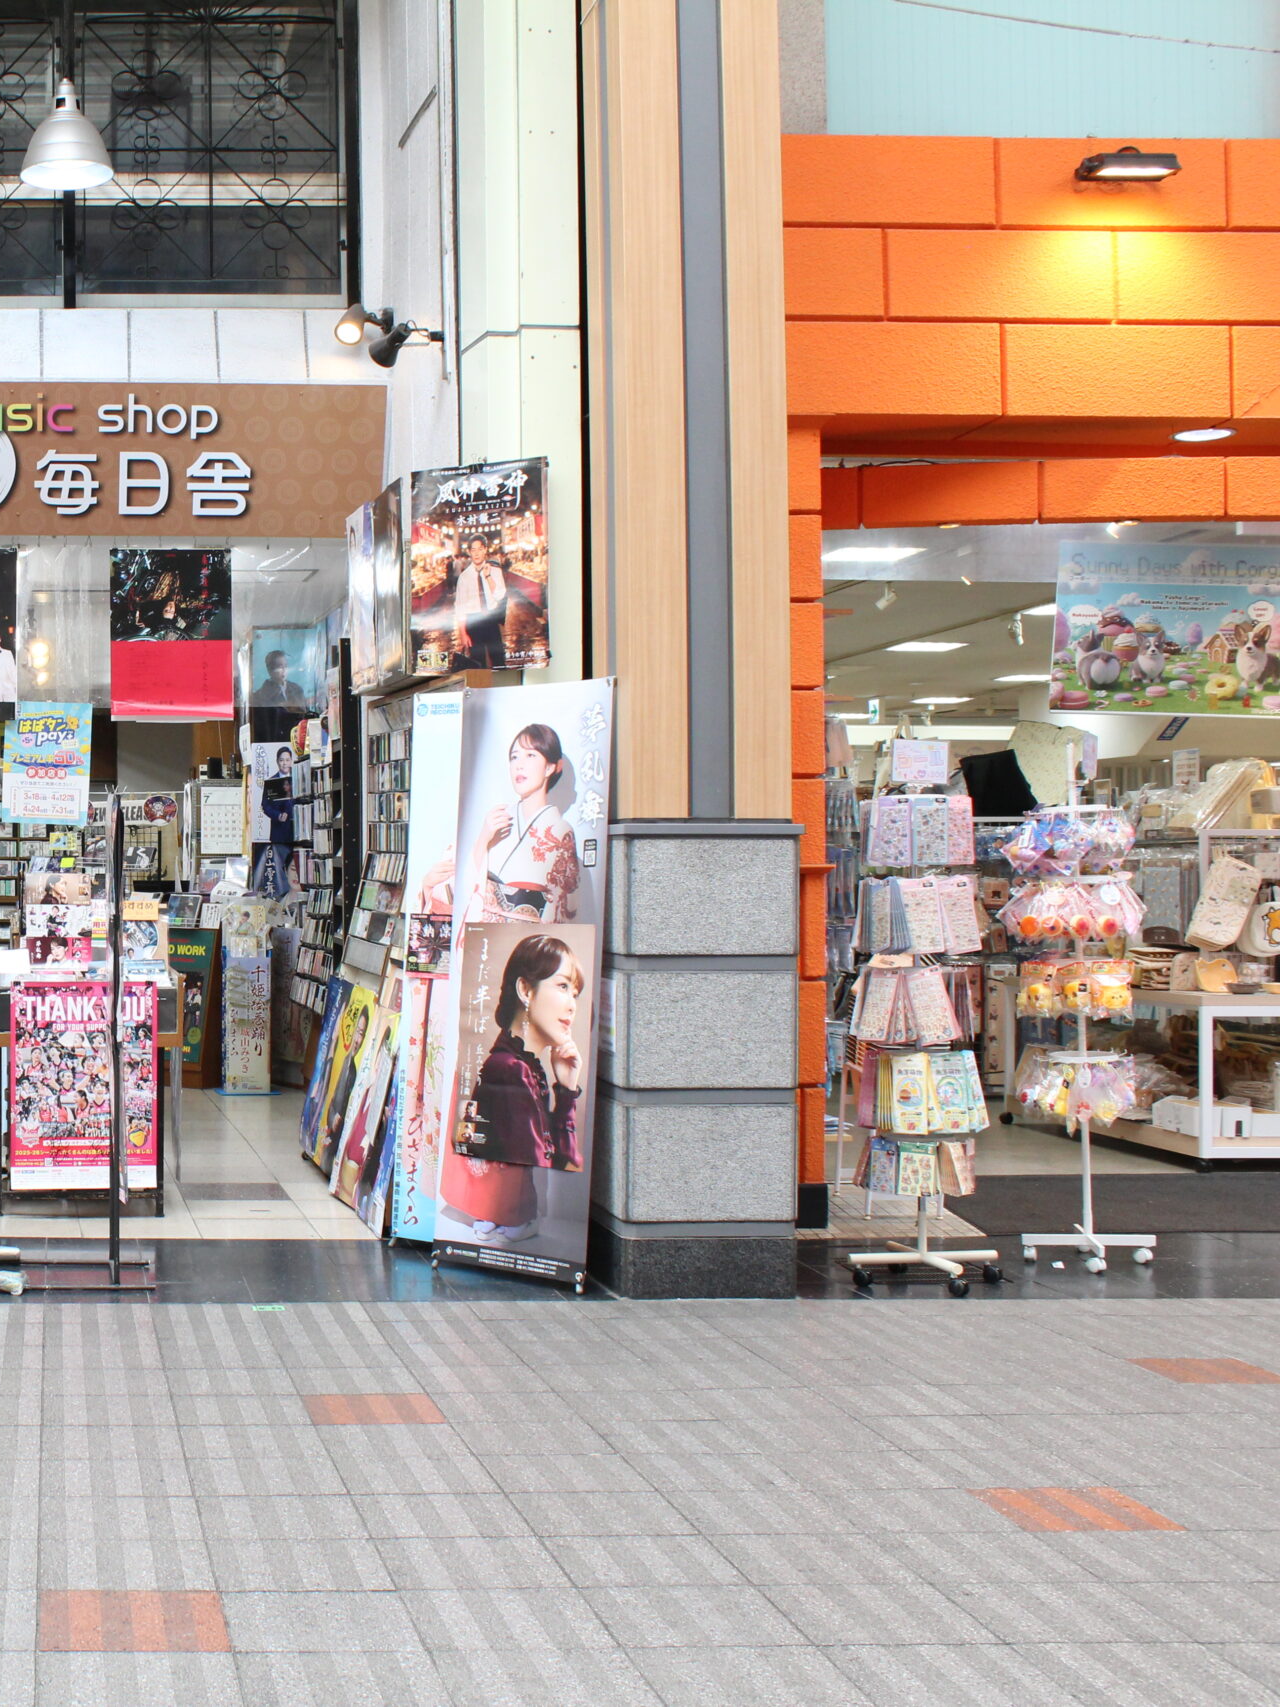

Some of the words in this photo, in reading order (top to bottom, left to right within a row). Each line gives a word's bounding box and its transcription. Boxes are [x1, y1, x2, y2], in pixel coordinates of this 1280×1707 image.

[97, 393, 219, 440] shop
[1070, 553, 1130, 576] Sunny
[1137, 556, 1182, 576] Days
[94, 806, 107, 822] EW
[177, 944, 206, 955] WORK
[22, 996, 98, 1021] THANK
[52, 1023, 65, 1031] FOR
[86, 1023, 107, 1031] SUPPO
[403, 1116, 423, 1226] ひざまくら
